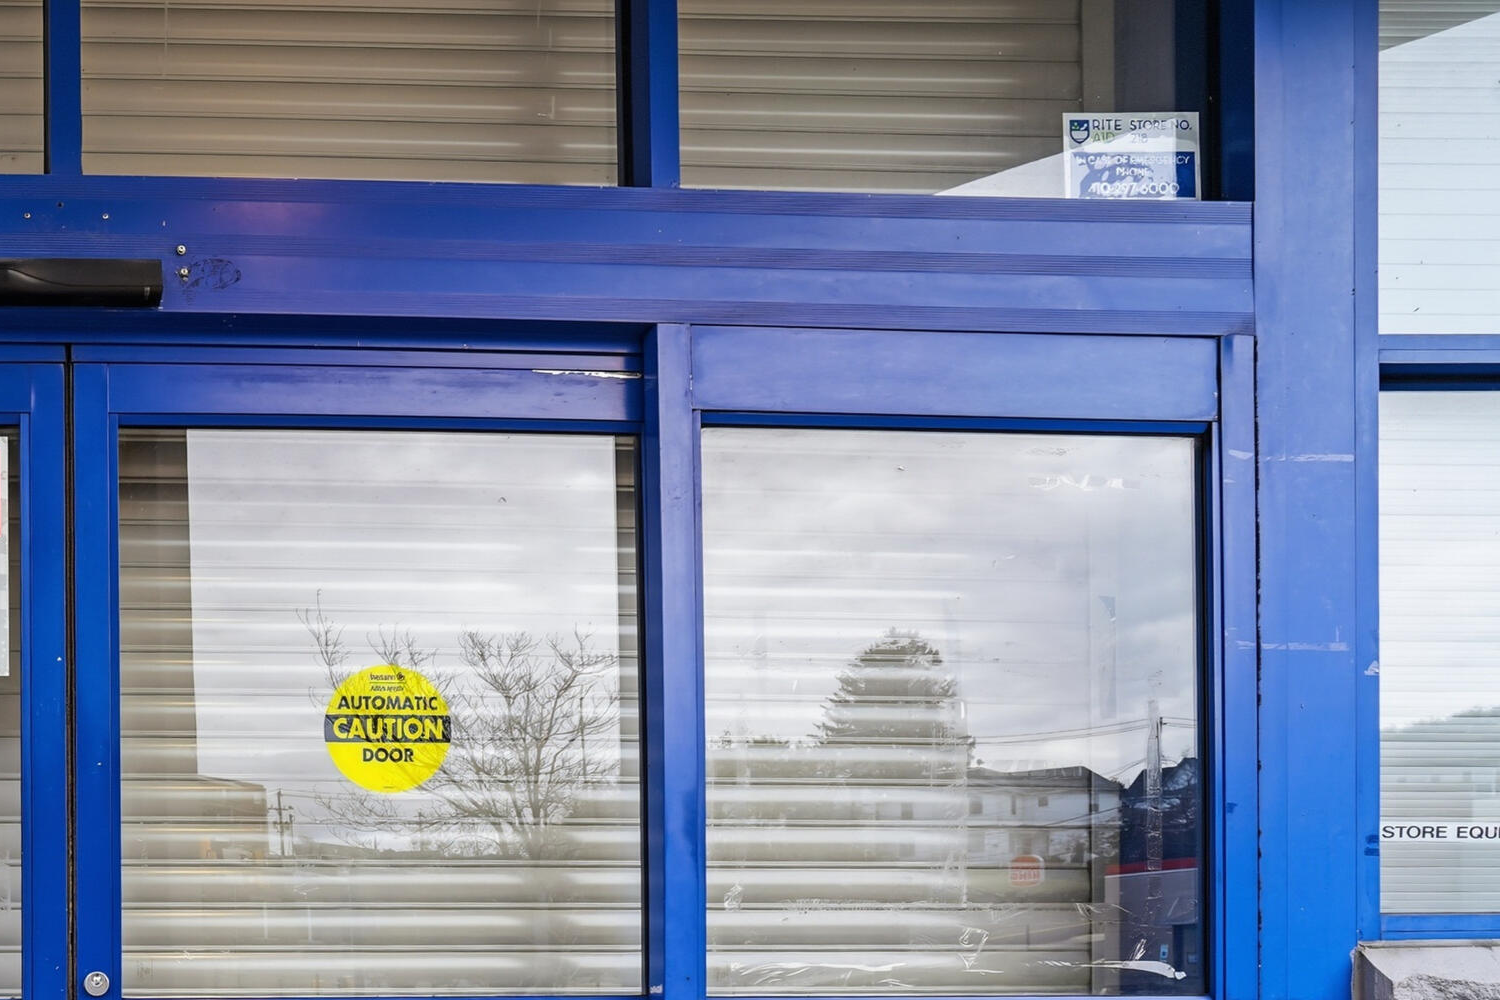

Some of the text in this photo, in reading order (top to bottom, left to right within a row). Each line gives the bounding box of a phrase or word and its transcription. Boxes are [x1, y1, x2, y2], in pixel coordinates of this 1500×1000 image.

[1092, 119, 1122, 131] RITE
[1130, 119, 1168, 131] STORE
[337, 695, 438, 711] AUTOMATIC
[333, 717, 444, 740] CAUTION
[362, 748, 414, 762] DOOR
[1381, 825, 1448, 838] STORE
